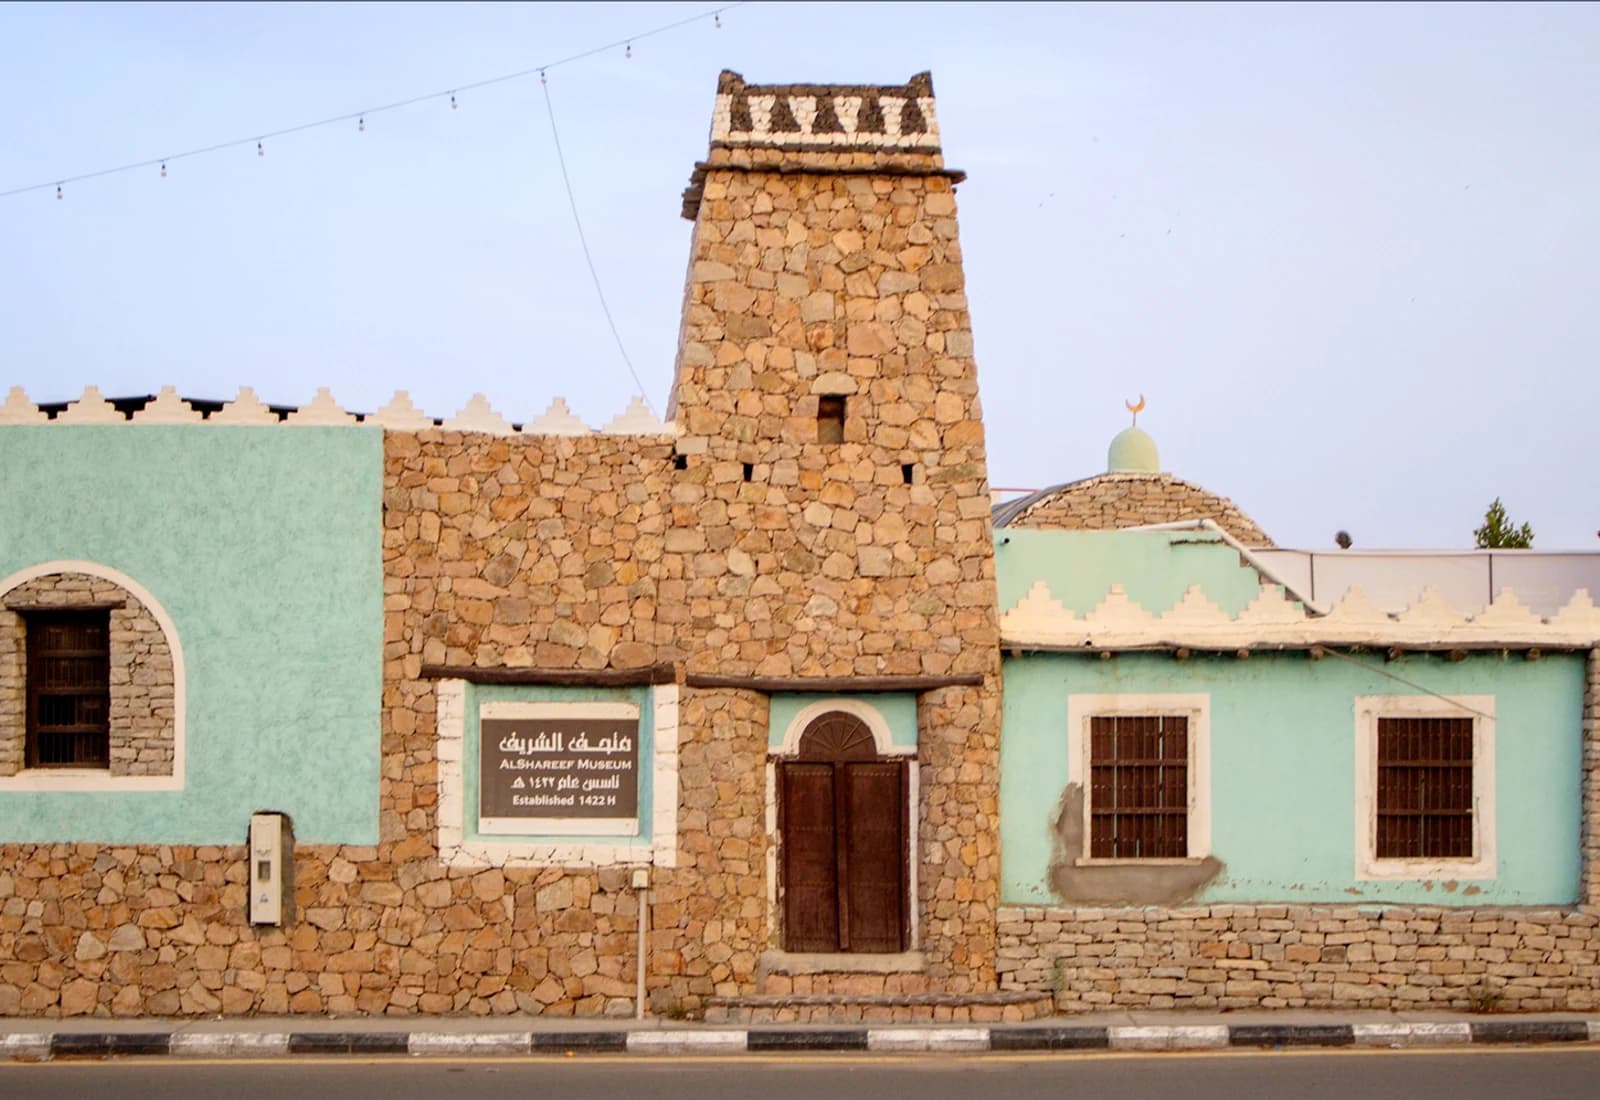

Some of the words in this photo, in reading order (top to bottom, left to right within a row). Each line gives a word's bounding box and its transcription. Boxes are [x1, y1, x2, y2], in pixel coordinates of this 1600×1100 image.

[499, 731, 564, 755] الشريف
[568, 731, 631, 755] متحف
[557, 774, 580, 791] عام
[512, 794, 575, 806] Established
[579, 795, 605, 806] 1422
[607, 795, 616, 806] H
